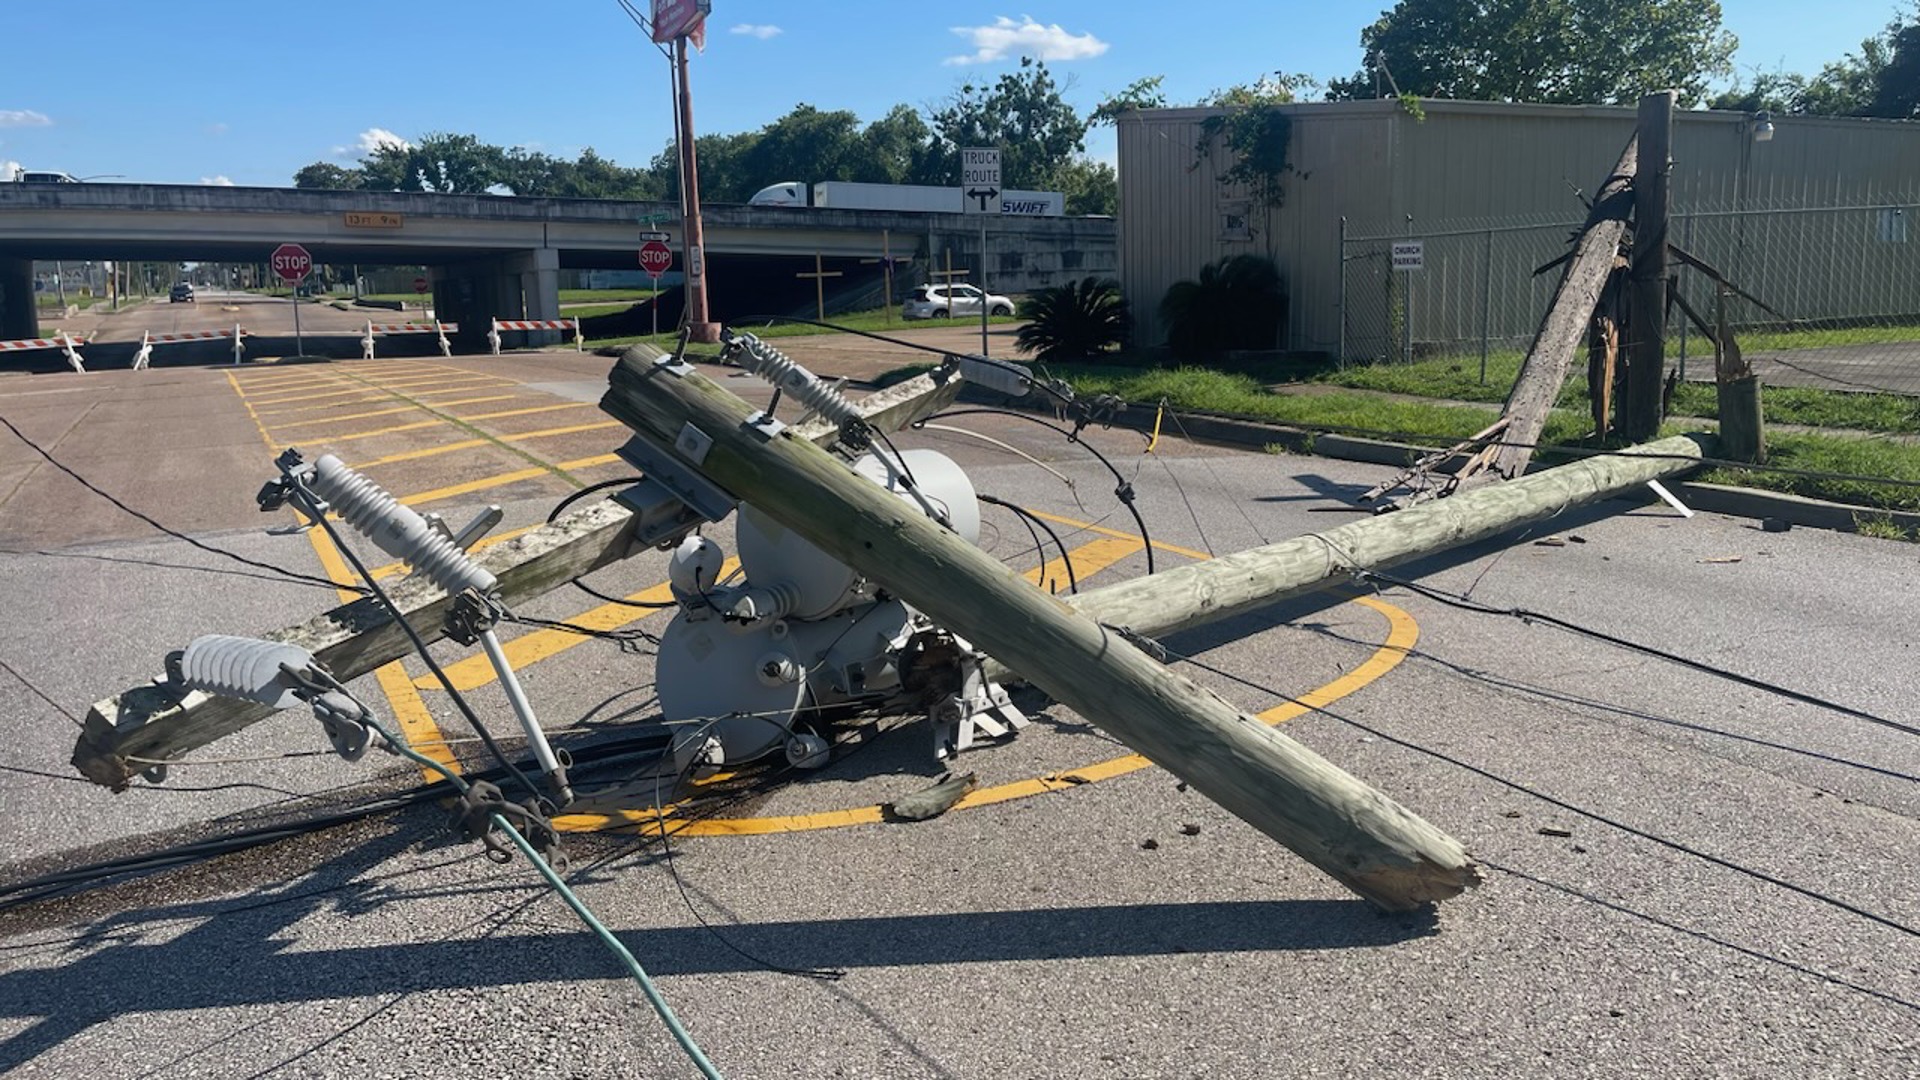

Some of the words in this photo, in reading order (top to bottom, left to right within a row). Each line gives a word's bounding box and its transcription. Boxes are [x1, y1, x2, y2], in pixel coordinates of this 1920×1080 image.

[965, 152, 999, 164] TRUCK
[965, 171, 999, 182] ROUTE
[1002, 201, 1050, 213] SWIFT
[349, 215, 360, 224] 13
[380, 215, 388, 224] 9
[1395, 246, 1420, 255] CHURCH
[641, 250, 670, 263] STOP
[1394, 257, 1421, 265] PARKING
[275, 256, 308, 270] STOP
